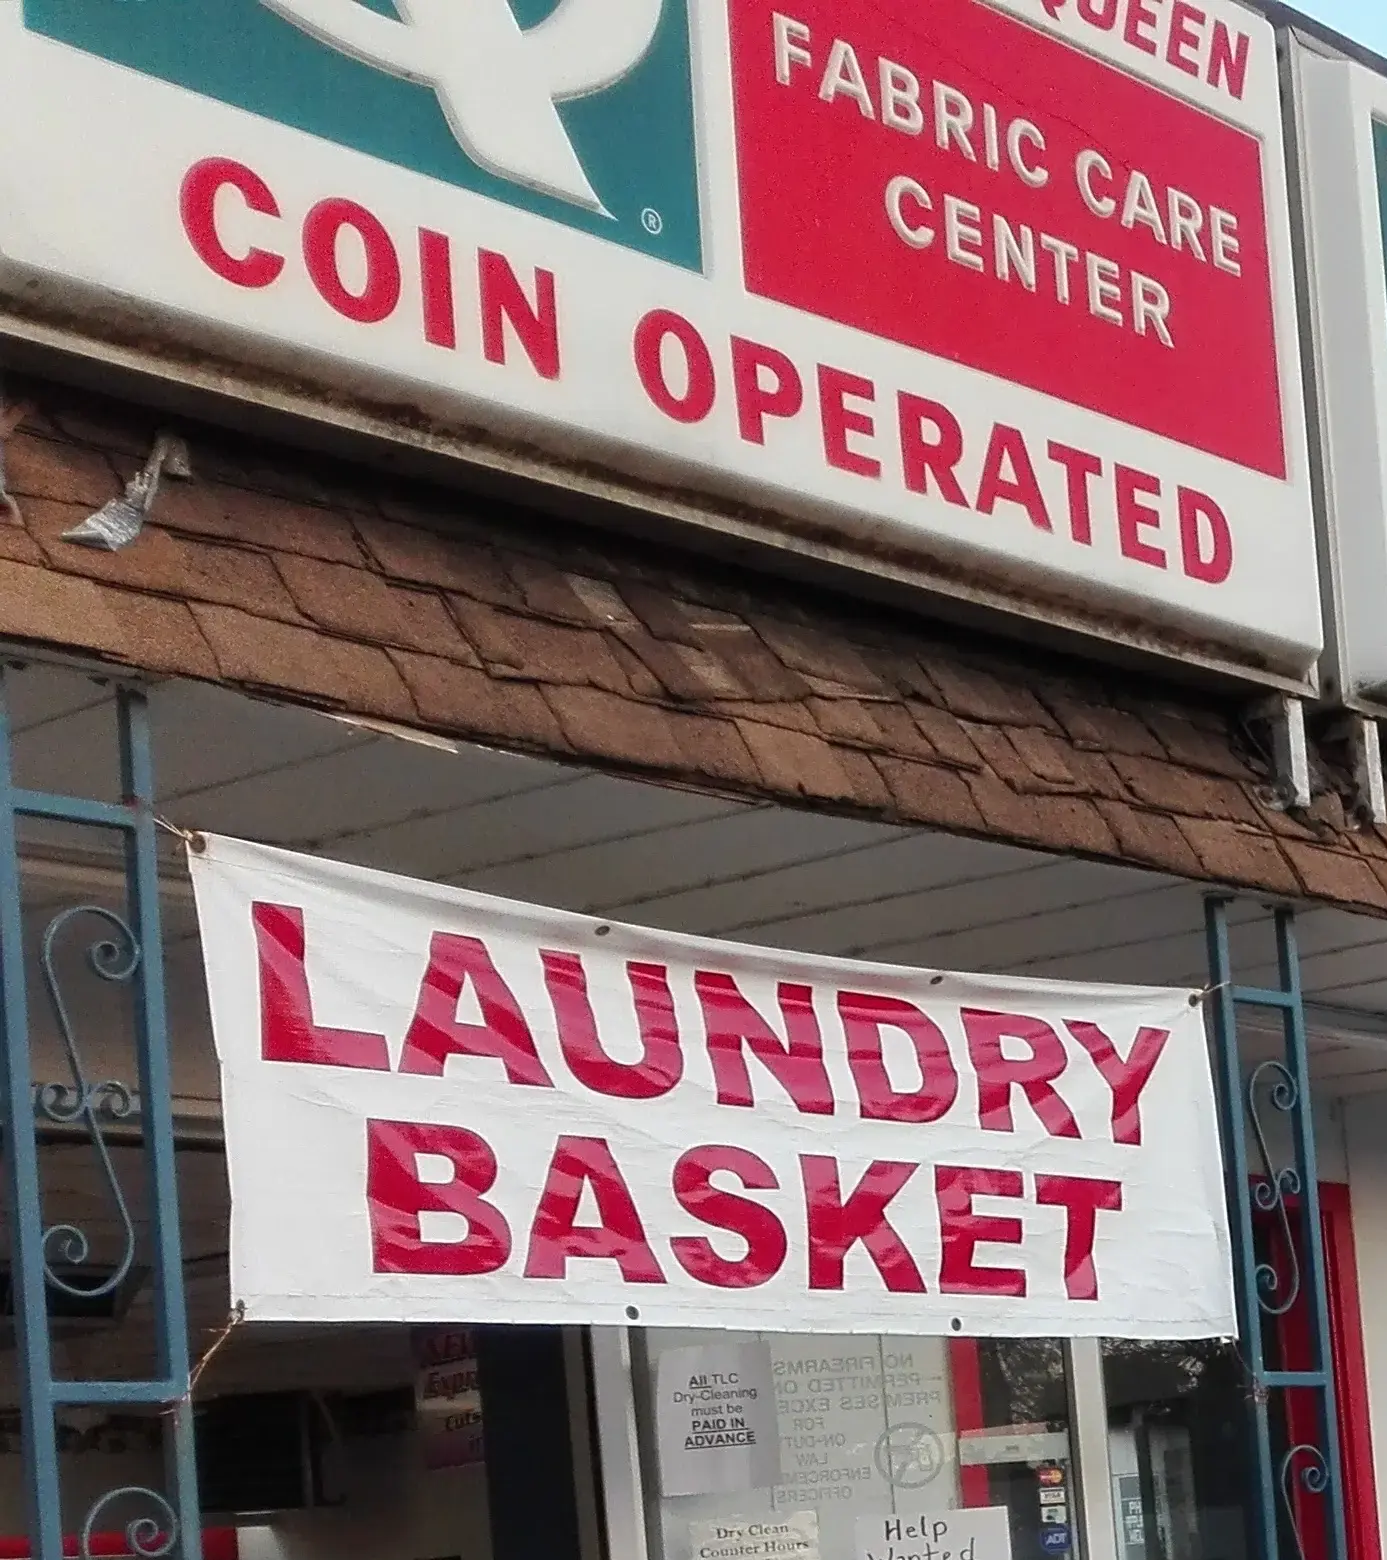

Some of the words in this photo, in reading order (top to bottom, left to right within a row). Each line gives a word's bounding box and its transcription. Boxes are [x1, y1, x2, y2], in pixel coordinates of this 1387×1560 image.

[1040, 0, 1250, 101] UEEN
[773, 13, 1051, 188] FABRIC
[1075, 149, 1244, 277] CARE
[884, 176, 1176, 349] CENTER
[178, 156, 562, 381] COIN
[634, 307, 1235, 585] OPERATED
[250, 900, 1171, 1147] LAUNDRY
[365, 1117, 1123, 1302] BASKET
[689, 1375, 709, 1388] All
[712, 1372, 739, 1385] TLC
[673, 1388, 757, 1404] Dry-Cleaning
[691, 1405, 723, 1416] must
[726, 1404, 743, 1414] be
[692, 1419, 726, 1431] PAID
[731, 1418, 746, 1429] IN
[685, 1431, 756, 1448] ADVANCE
[716, 1527, 742, 1541] Dry
[748, 1524, 789, 1537] Clean
[885, 1516, 947, 1543] Help
[1046, 1533, 1067, 1545] ADT
[700, 1544, 760, 1558] Counter
[763, 1540, 809, 1553] Hours
